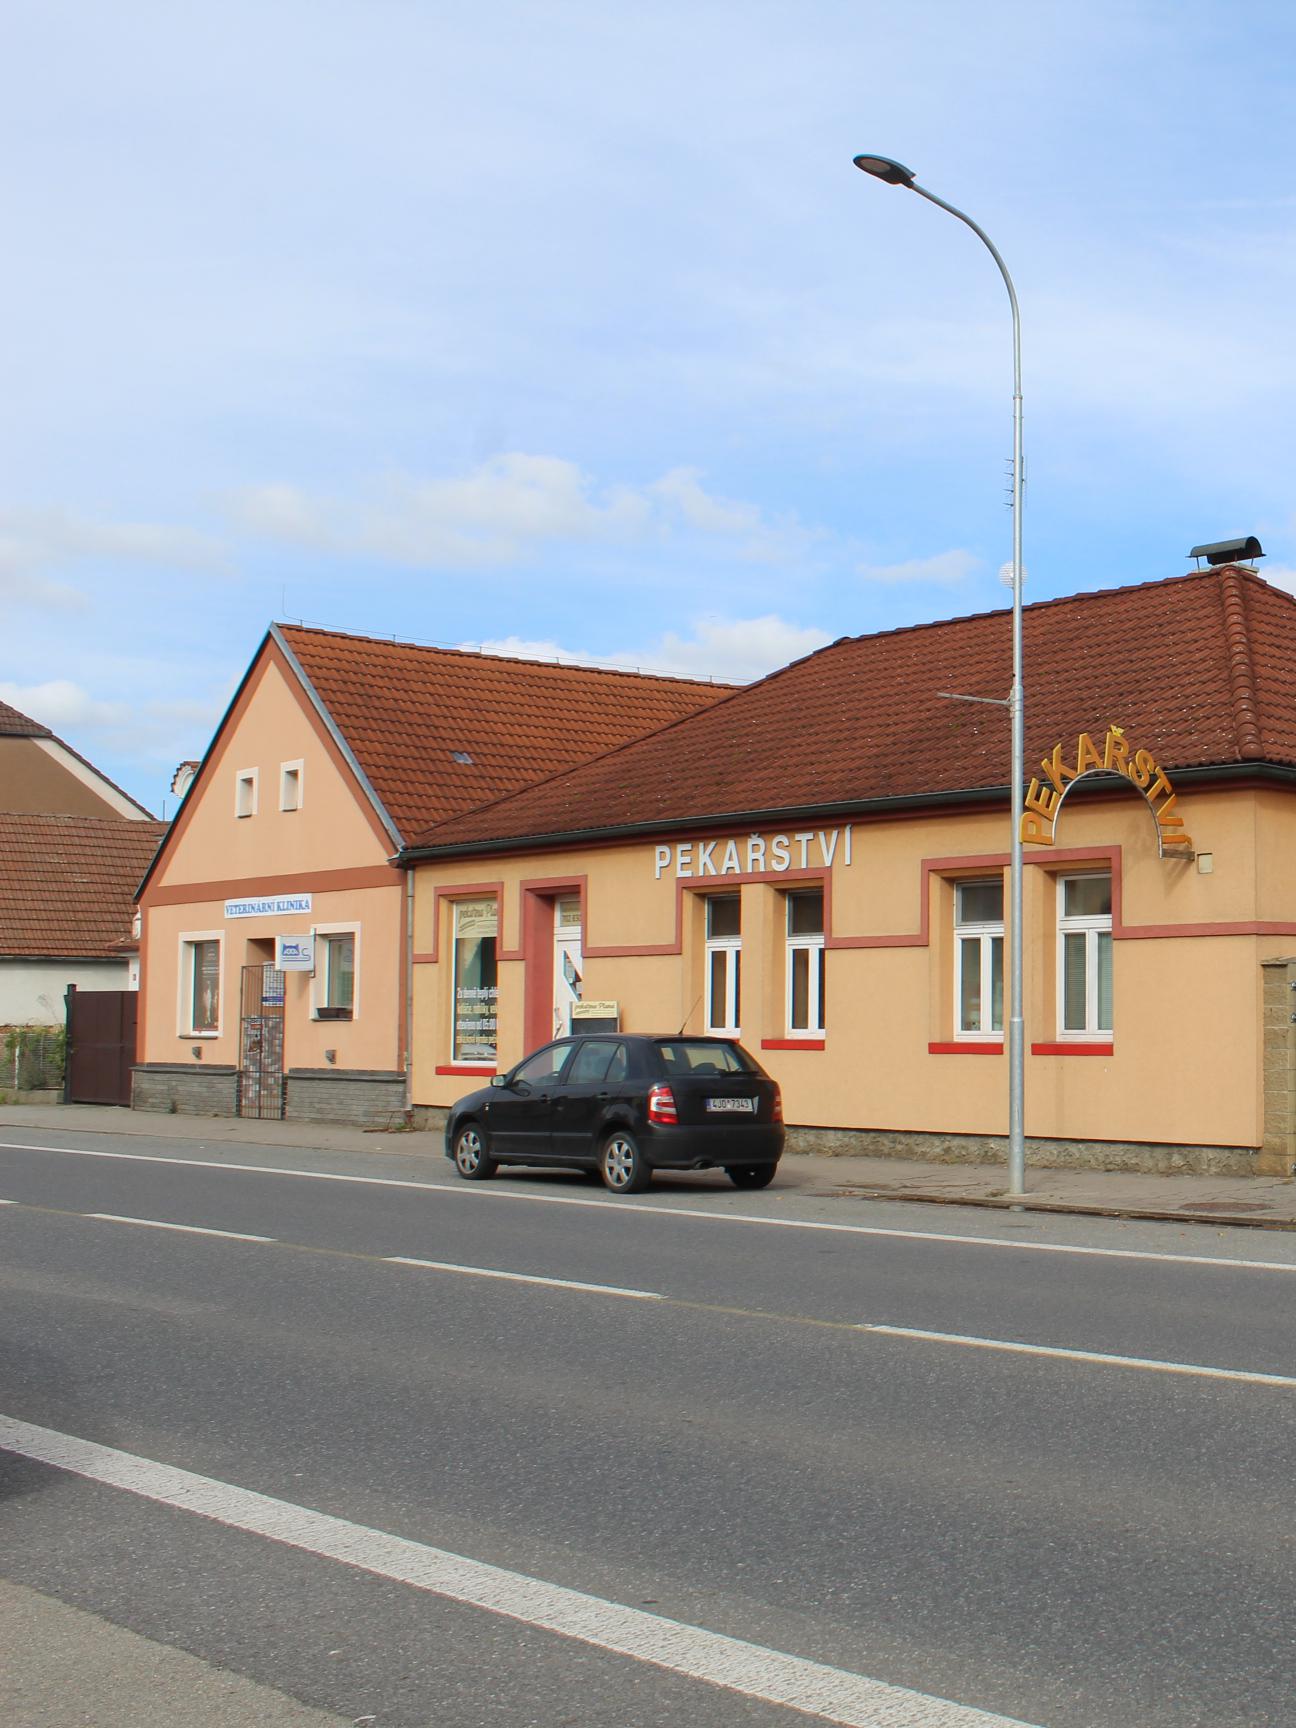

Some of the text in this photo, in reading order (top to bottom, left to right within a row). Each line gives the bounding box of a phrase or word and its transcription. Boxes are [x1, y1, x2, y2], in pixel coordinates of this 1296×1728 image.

[1020, 724, 1192, 848] PEKAŘSTVÍ
[655, 823, 852, 879] PEKAŘSTVÍ
[276, 898, 310, 912] KLINIKA
